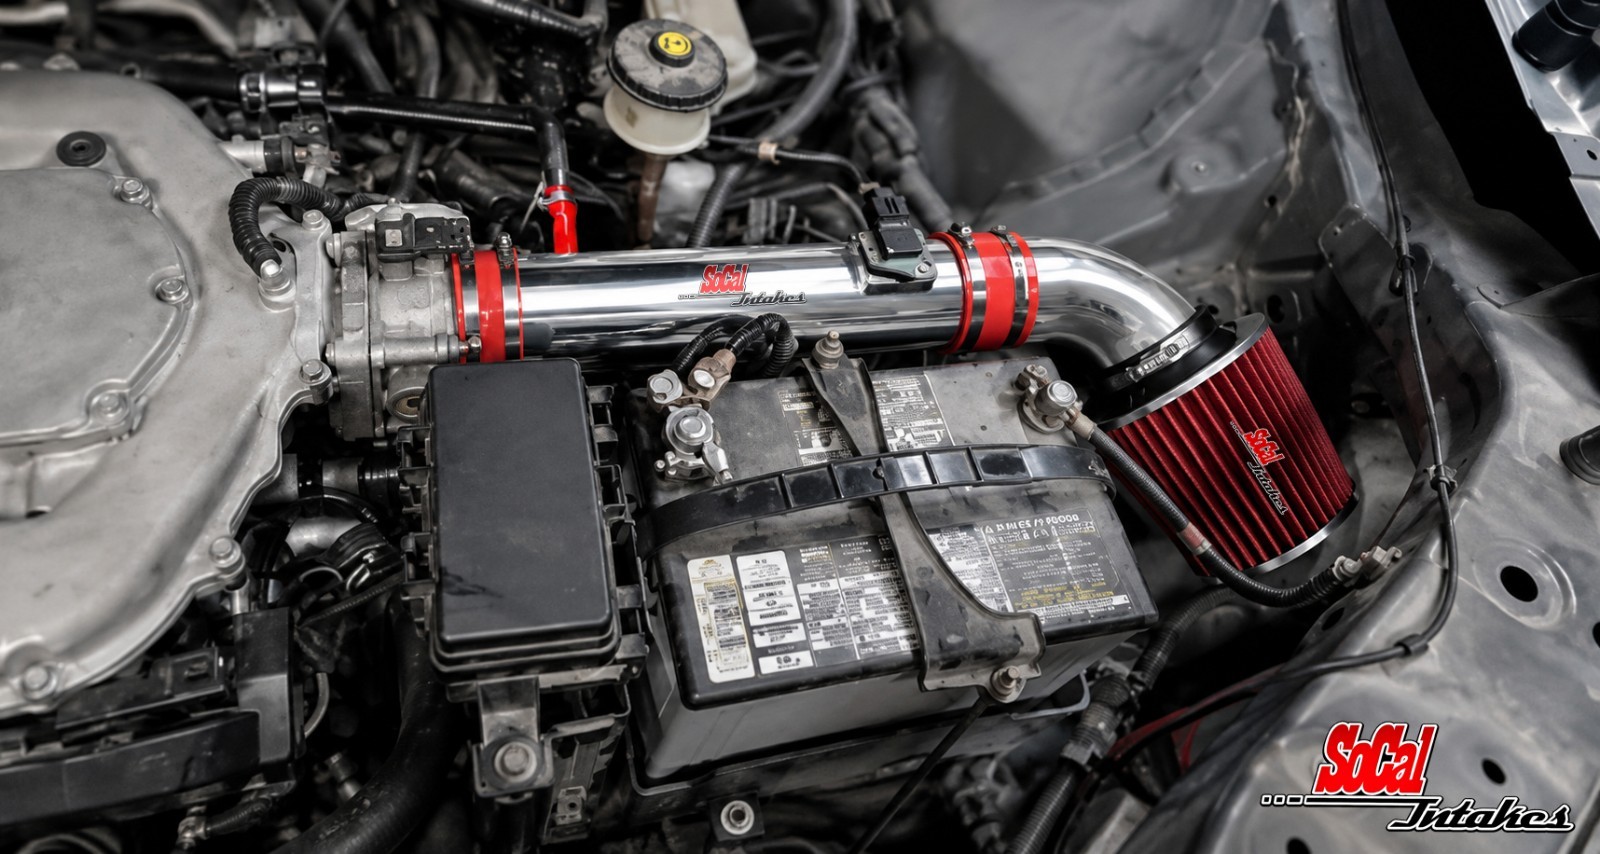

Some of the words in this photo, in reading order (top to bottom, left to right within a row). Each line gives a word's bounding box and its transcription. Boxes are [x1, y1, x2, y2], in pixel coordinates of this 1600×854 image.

[699, 264, 750, 294] SoCal
[730, 290, 807, 307] Intakes
[1243, 428, 1285, 466] SoCal
[1247, 461, 1288, 515] Intakes
